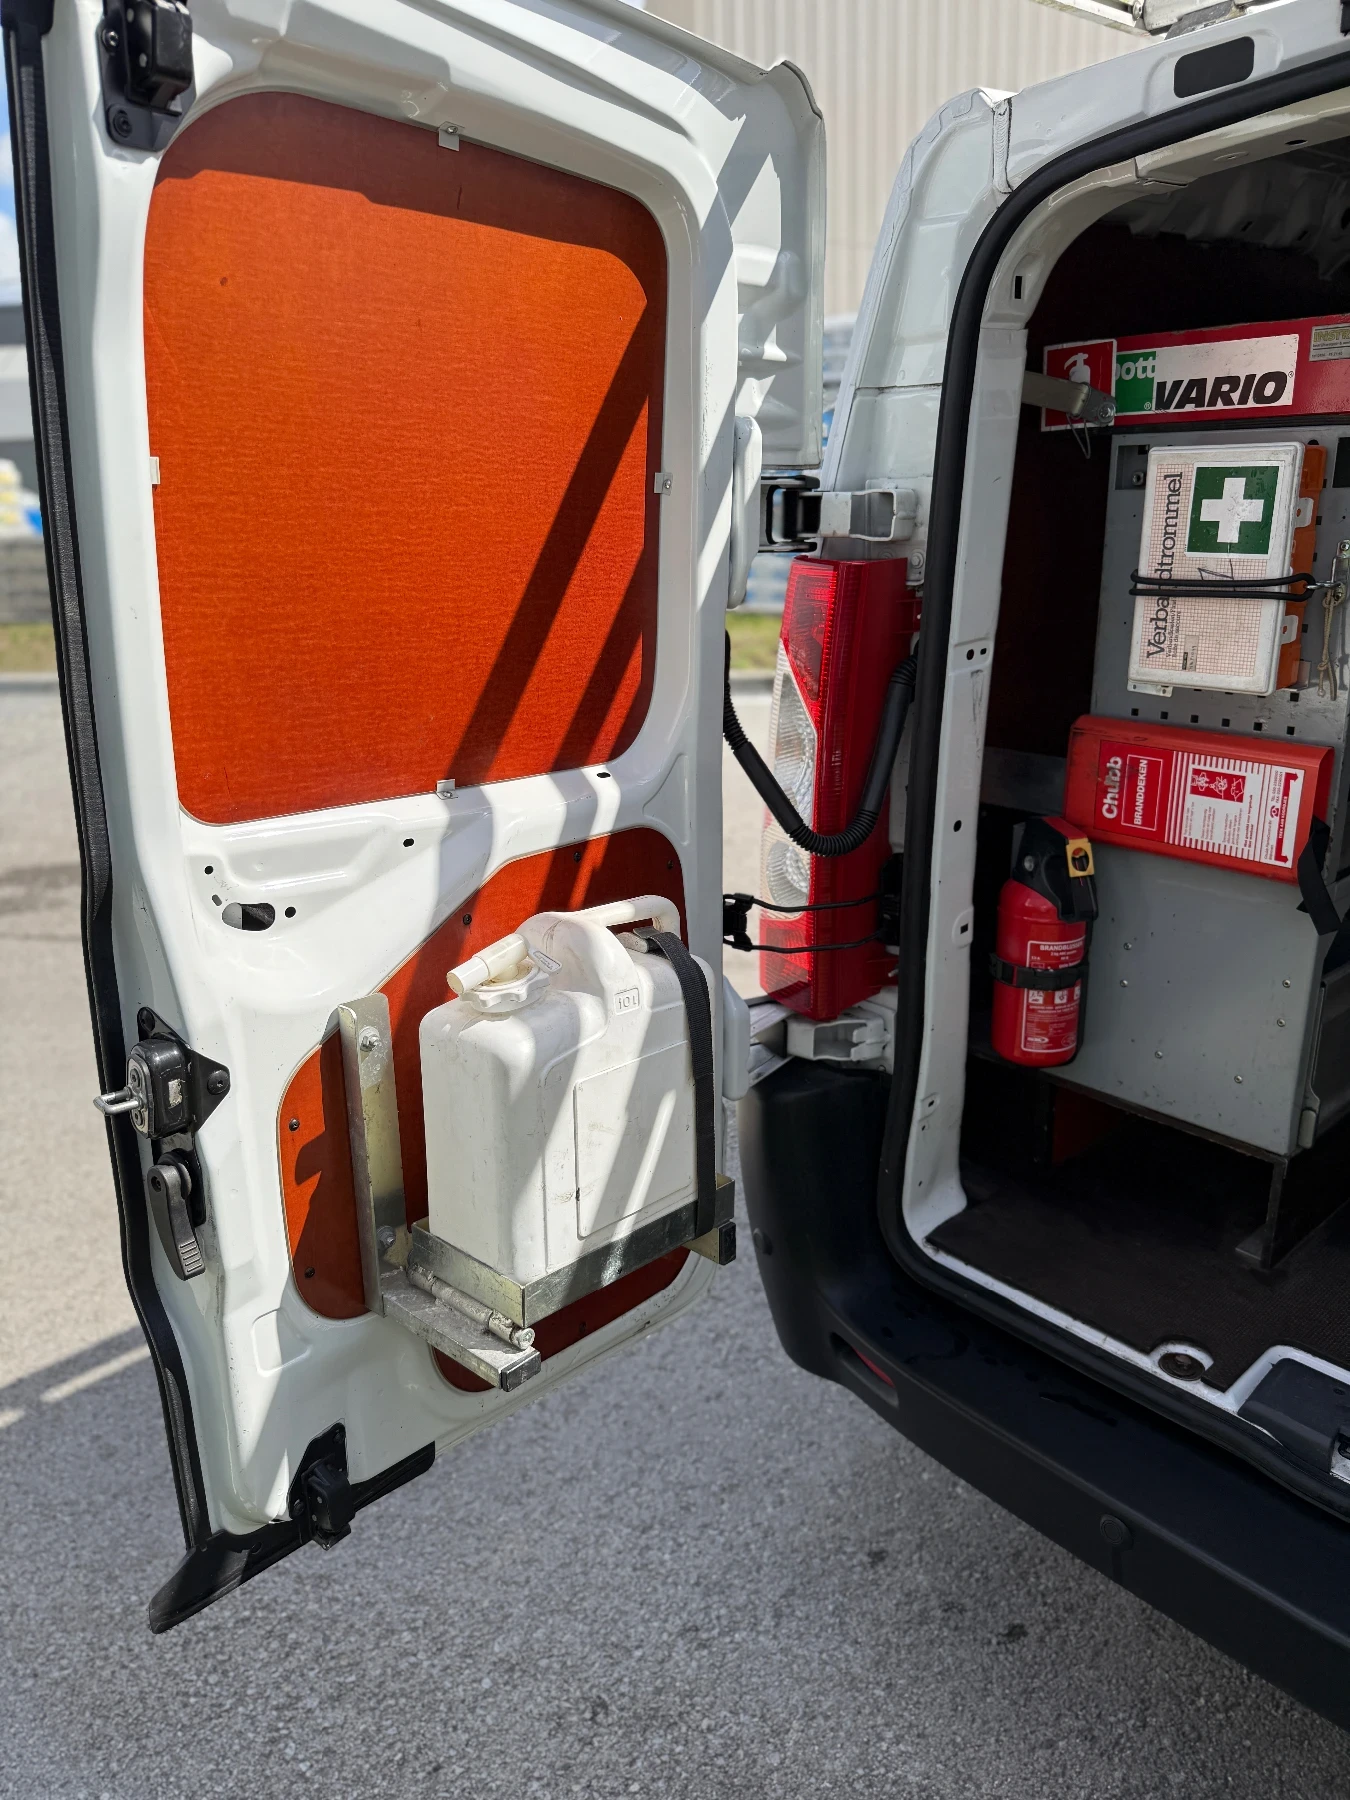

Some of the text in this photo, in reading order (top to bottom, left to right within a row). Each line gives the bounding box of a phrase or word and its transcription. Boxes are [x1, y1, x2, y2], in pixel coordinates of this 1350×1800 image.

[1154, 371, 1288, 411] VARIO
[1102, 756, 1122, 819] Chubb
[1134, 760, 1148, 825] BRANDDEKEN
